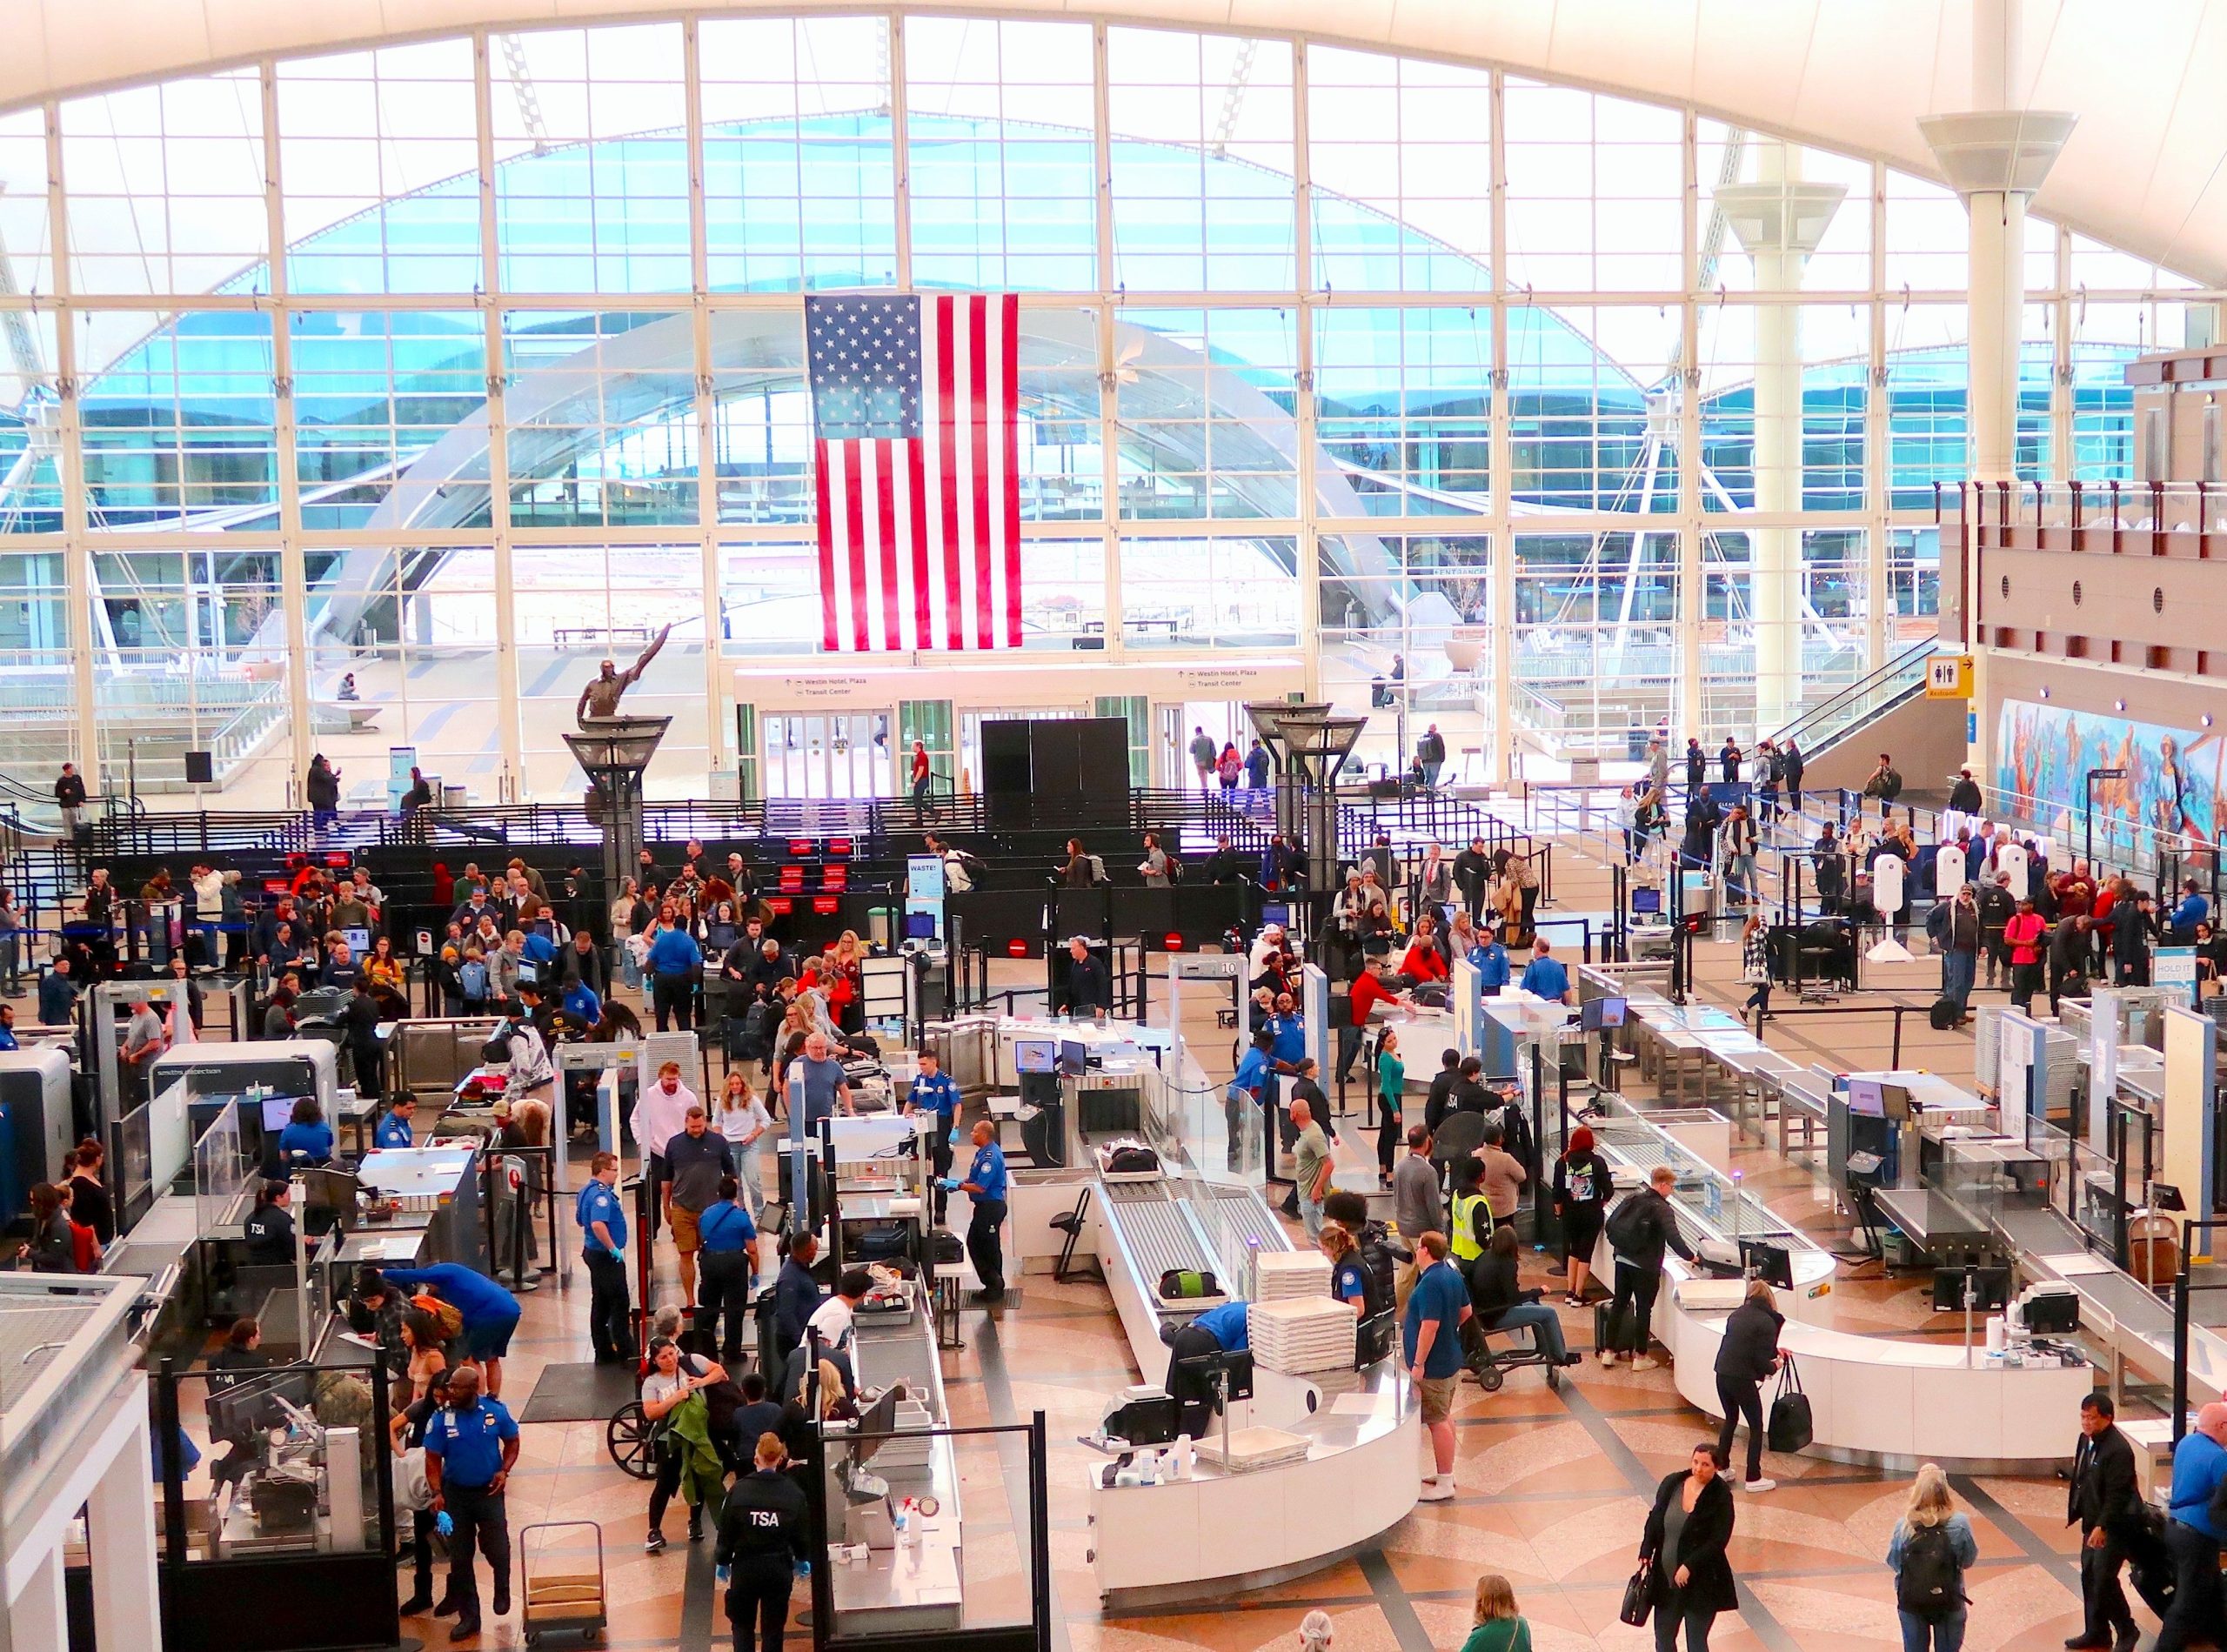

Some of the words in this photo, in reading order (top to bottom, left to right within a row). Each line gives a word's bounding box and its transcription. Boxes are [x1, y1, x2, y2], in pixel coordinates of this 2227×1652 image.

[1222, 962, 1236, 973] 10
[2163, 996, 2177, 1005] 11
[1447, 1093, 1458, 1109] SA
[251, 1222, 265, 1235] TSA
[749, 1511, 779, 1528] TSA
